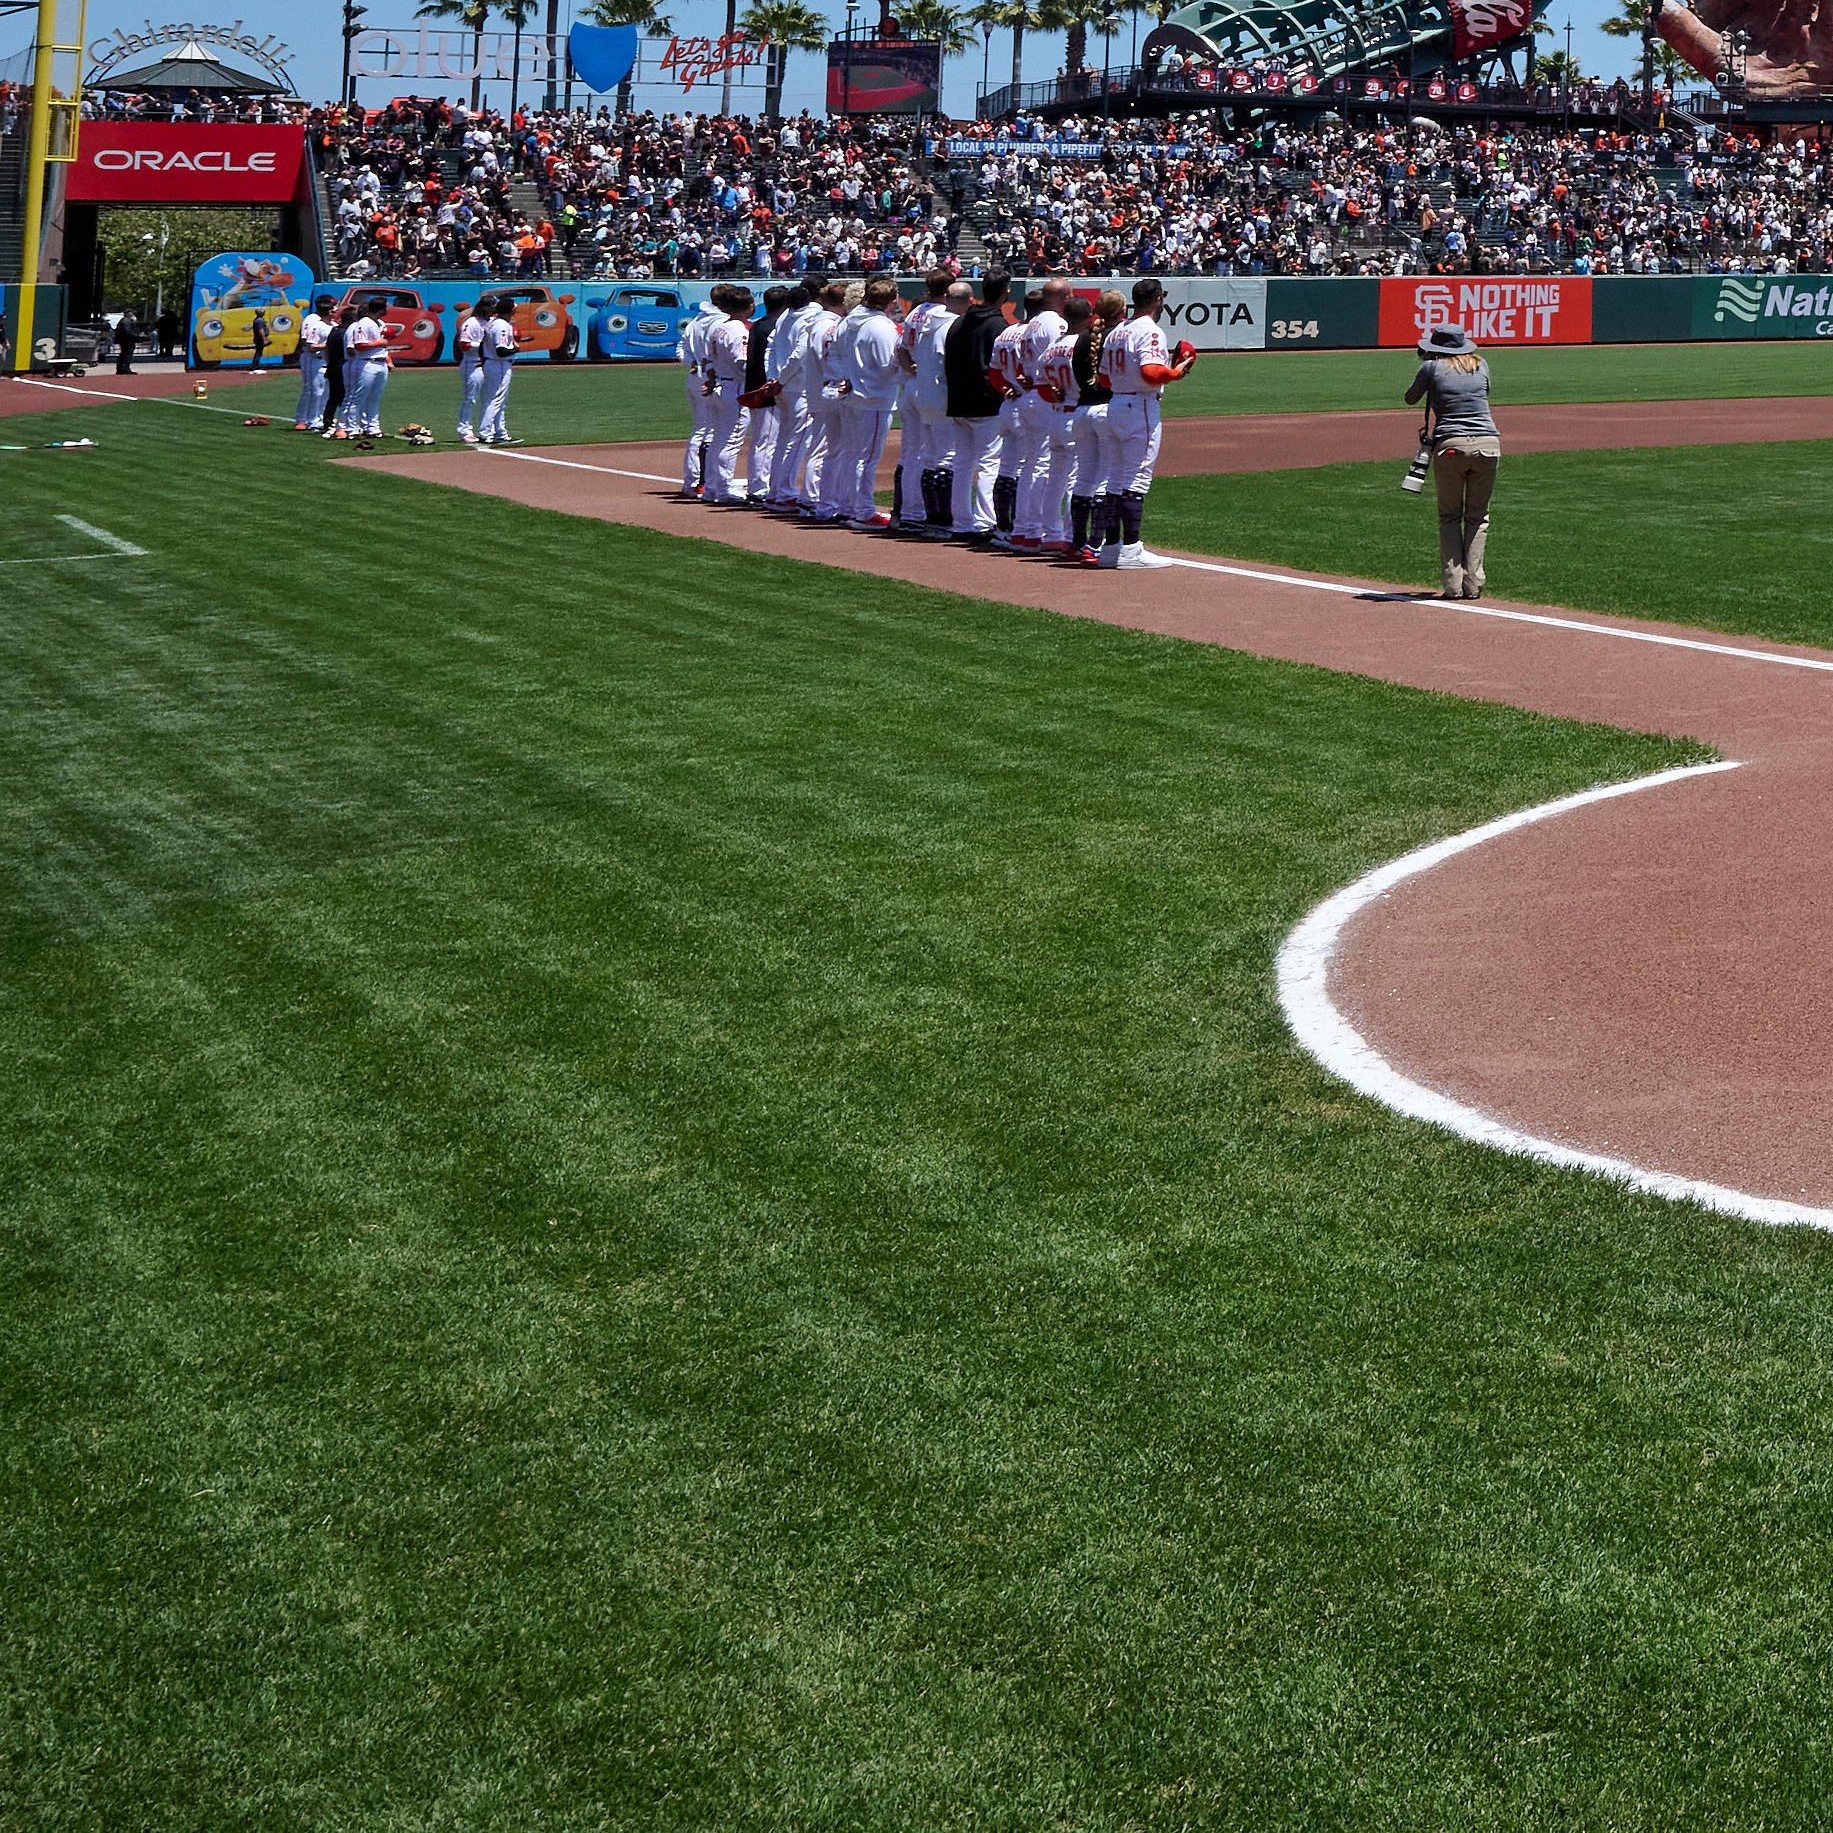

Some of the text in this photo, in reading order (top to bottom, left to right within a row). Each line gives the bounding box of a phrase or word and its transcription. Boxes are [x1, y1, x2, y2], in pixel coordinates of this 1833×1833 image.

[87, 19, 296, 74] Ghirardelli
[950, 142, 980, 153] LOCAL
[94, 150, 276, 172] ORACLE
[1459, 284, 1560, 311] NOTHING
[1271, 320, 1319, 339] 354
[1459, 306, 1559, 339] LIKE IT
